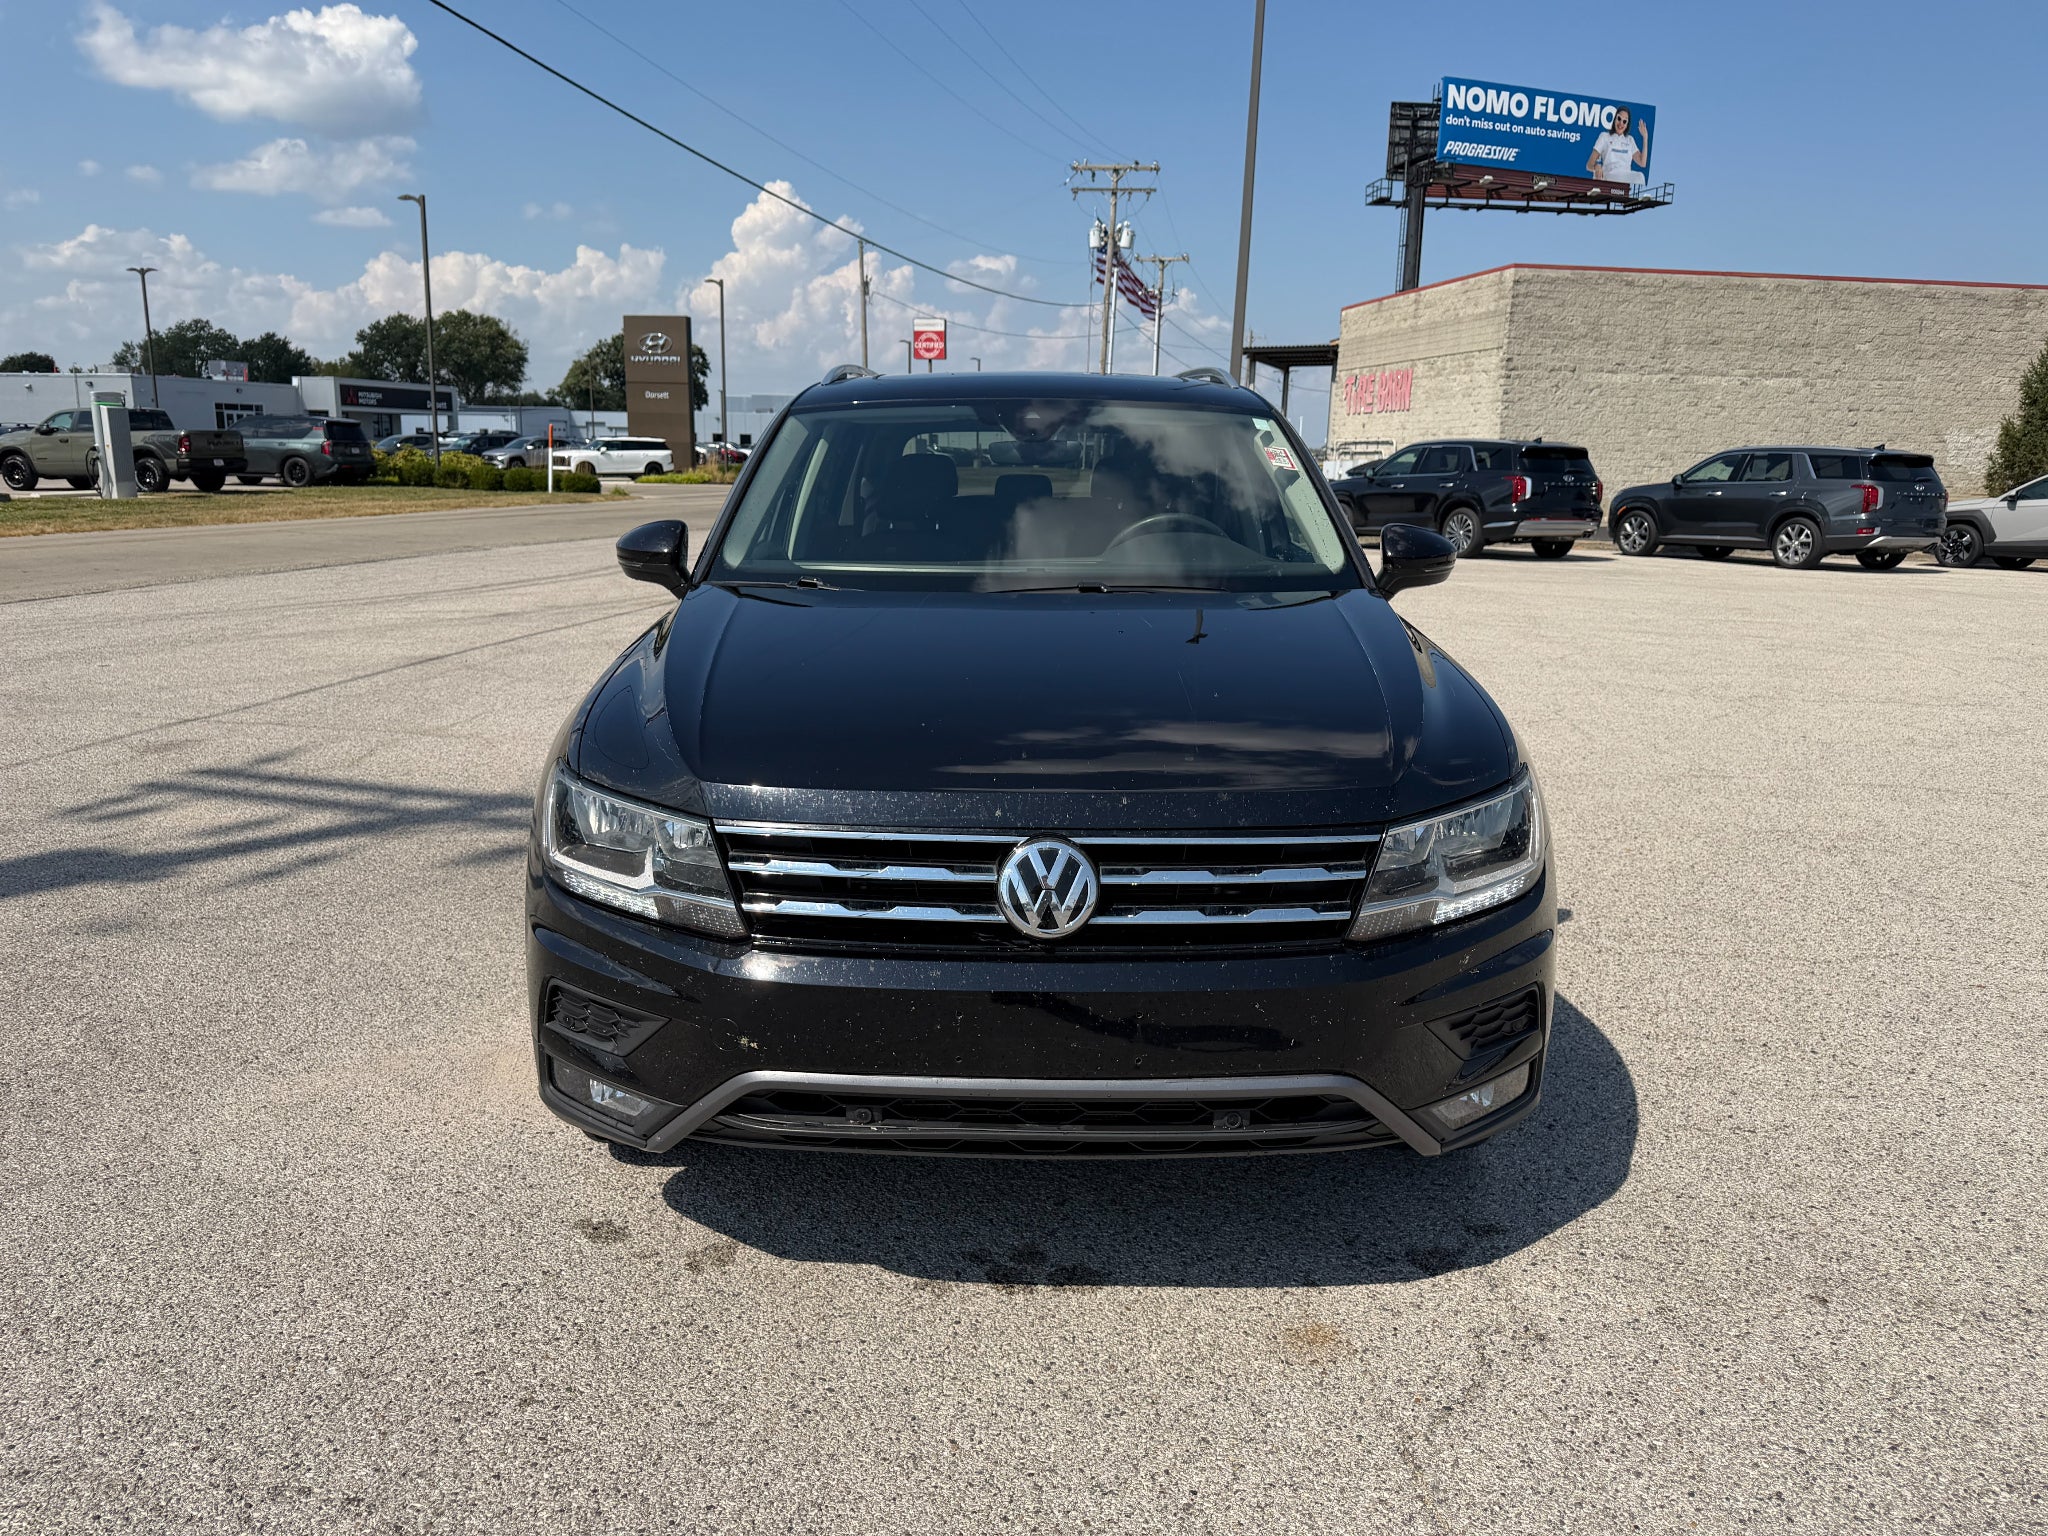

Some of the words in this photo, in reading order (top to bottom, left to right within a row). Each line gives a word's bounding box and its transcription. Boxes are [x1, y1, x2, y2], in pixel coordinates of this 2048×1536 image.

[1447, 83, 1529, 118] NOMO
[1533, 95, 1617, 130] FLOMO
[1445, 113, 1470, 127] don't
[1471, 118, 1493, 130] miss
[1494, 122, 1511, 132] out
[1512, 125, 1524, 133] on
[1525, 126, 1546, 136] auto
[1547, 129, 1581, 143] savings
[1443, 140, 1518, 161] PROGRESSIVE
[645, 390, 669, 399] Dorsett
[1343, 374, 1376, 415] TIRE
[1377, 368, 1413, 412] BARN
